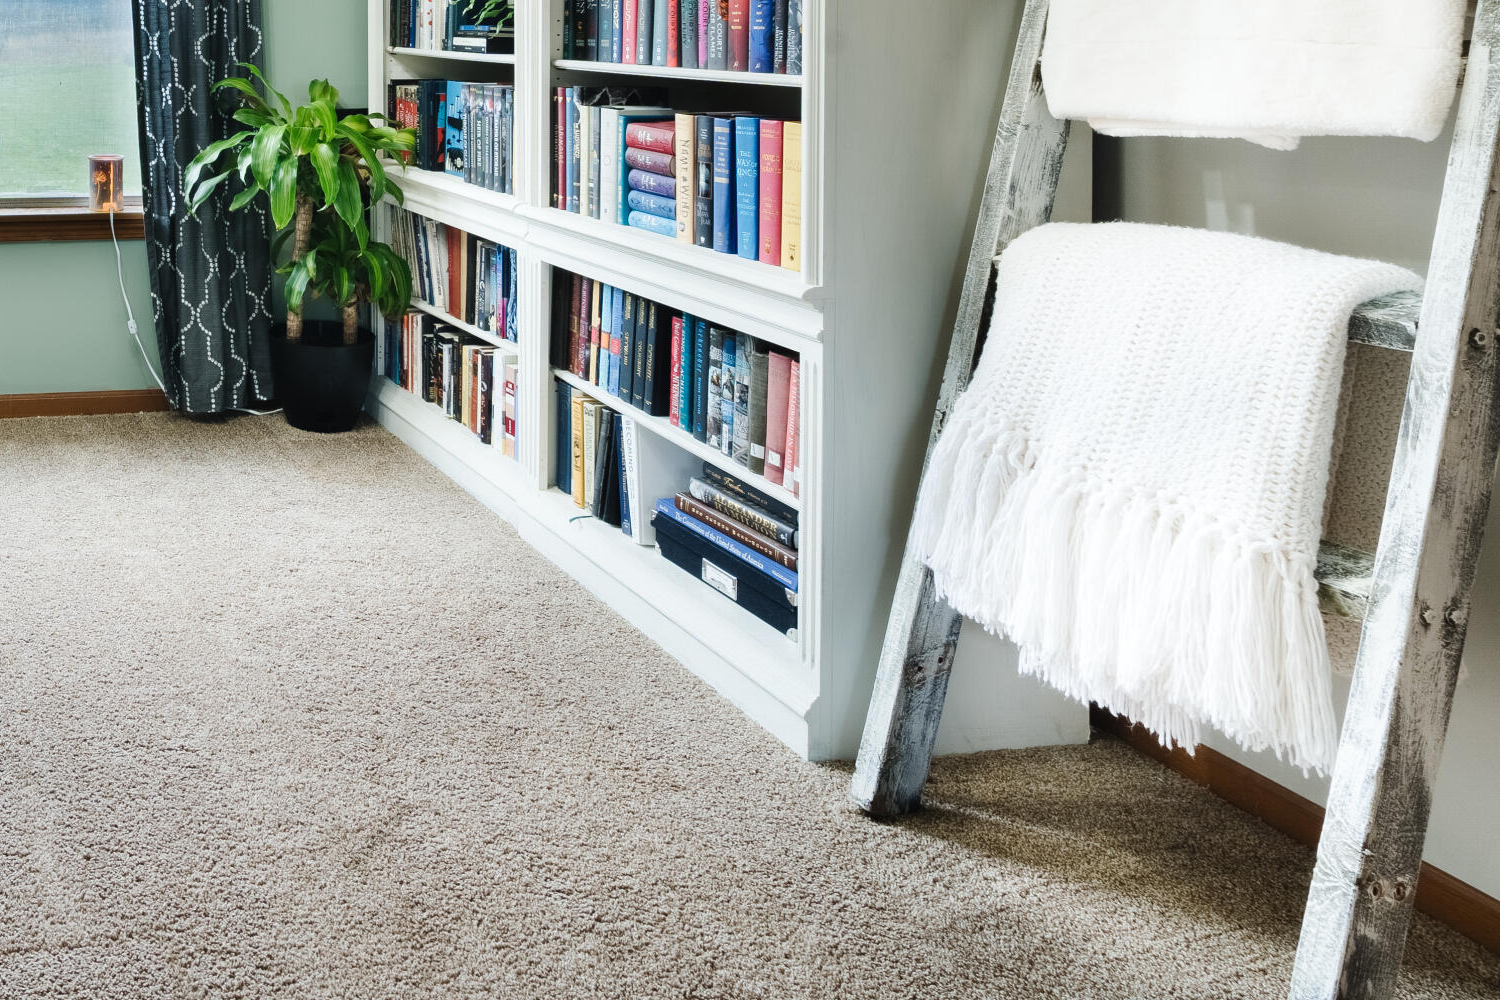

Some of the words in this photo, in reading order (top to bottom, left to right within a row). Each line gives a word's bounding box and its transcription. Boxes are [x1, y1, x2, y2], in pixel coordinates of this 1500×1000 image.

[679, 139, 691, 173] NAME
[737, 159, 751, 167] WAY
[737, 168, 758, 178] KINGS
[680, 184, 690, 218] WIND
[671, 374, 680, 417] NEVERWHERE
[625, 419, 634, 473] BECOMING
[714, 493, 778, 532] ALEXANDER
[714, 501, 778, 541] HAMILTON
